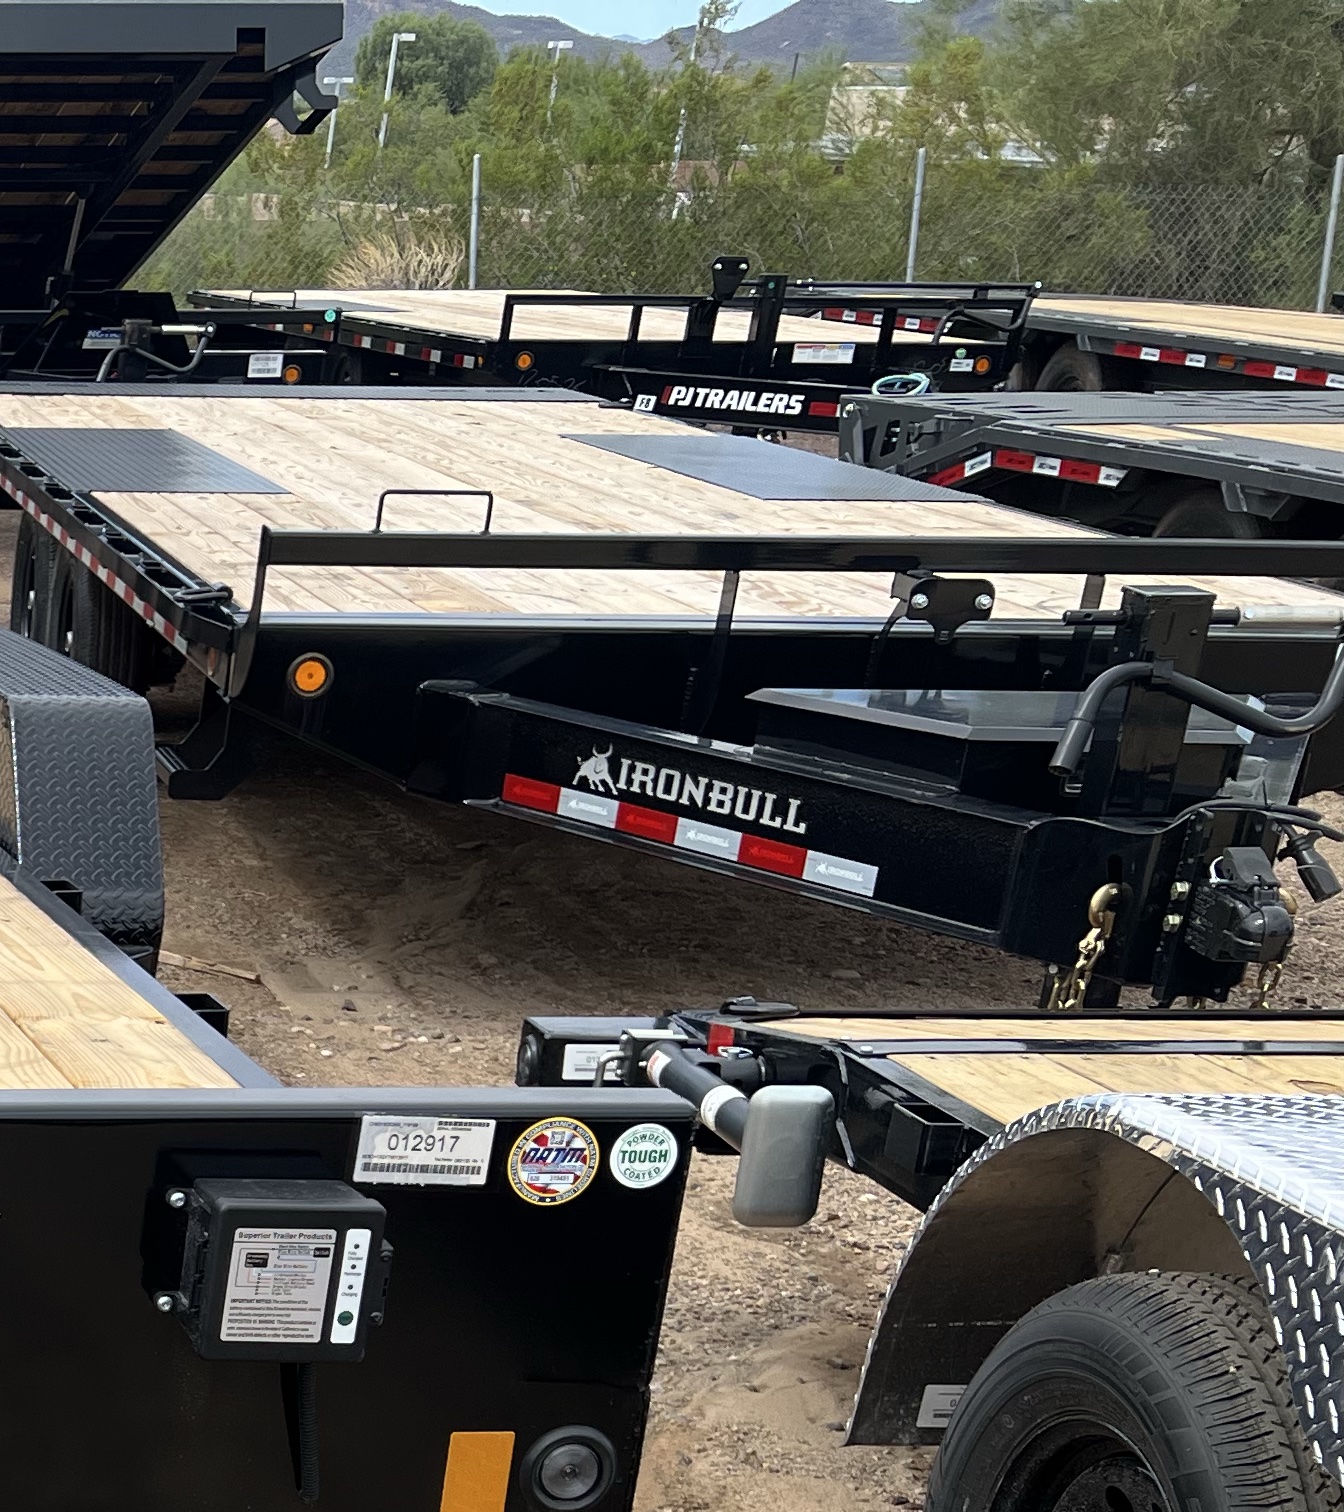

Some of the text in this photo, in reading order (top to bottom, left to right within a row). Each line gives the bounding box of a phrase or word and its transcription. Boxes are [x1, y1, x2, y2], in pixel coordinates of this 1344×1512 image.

[668, 385, 806, 415] PJ TRAILERS
[616, 756, 809, 835] IRONBULL
[388, 1133, 461, 1153] 012917
[627, 1132, 667, 1148] POWDER
[621, 1149, 669, 1165] TOUGH
[623, 1166, 662, 1181] COATED
[238, 1231, 333, 1241] Superior Trailer Products
